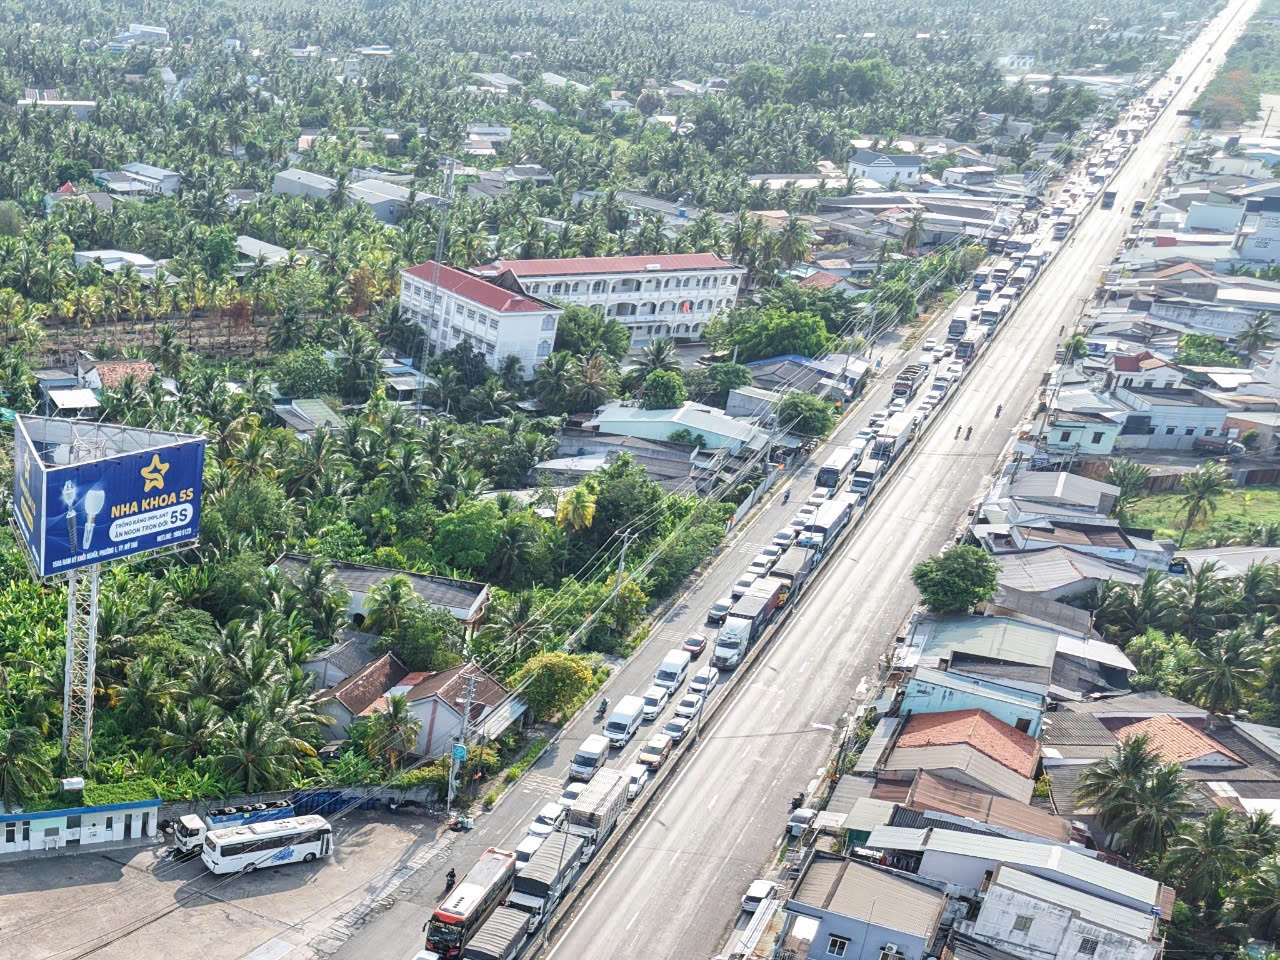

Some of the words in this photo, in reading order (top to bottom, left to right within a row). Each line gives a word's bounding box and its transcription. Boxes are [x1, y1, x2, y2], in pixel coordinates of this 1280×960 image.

[111, 501, 138, 518] NHA
[141, 492, 177, 511] KHOA
[179, 487, 194, 502] 5S
[170, 508, 188, 524] 5S
[123, 527, 141, 537] NGON
